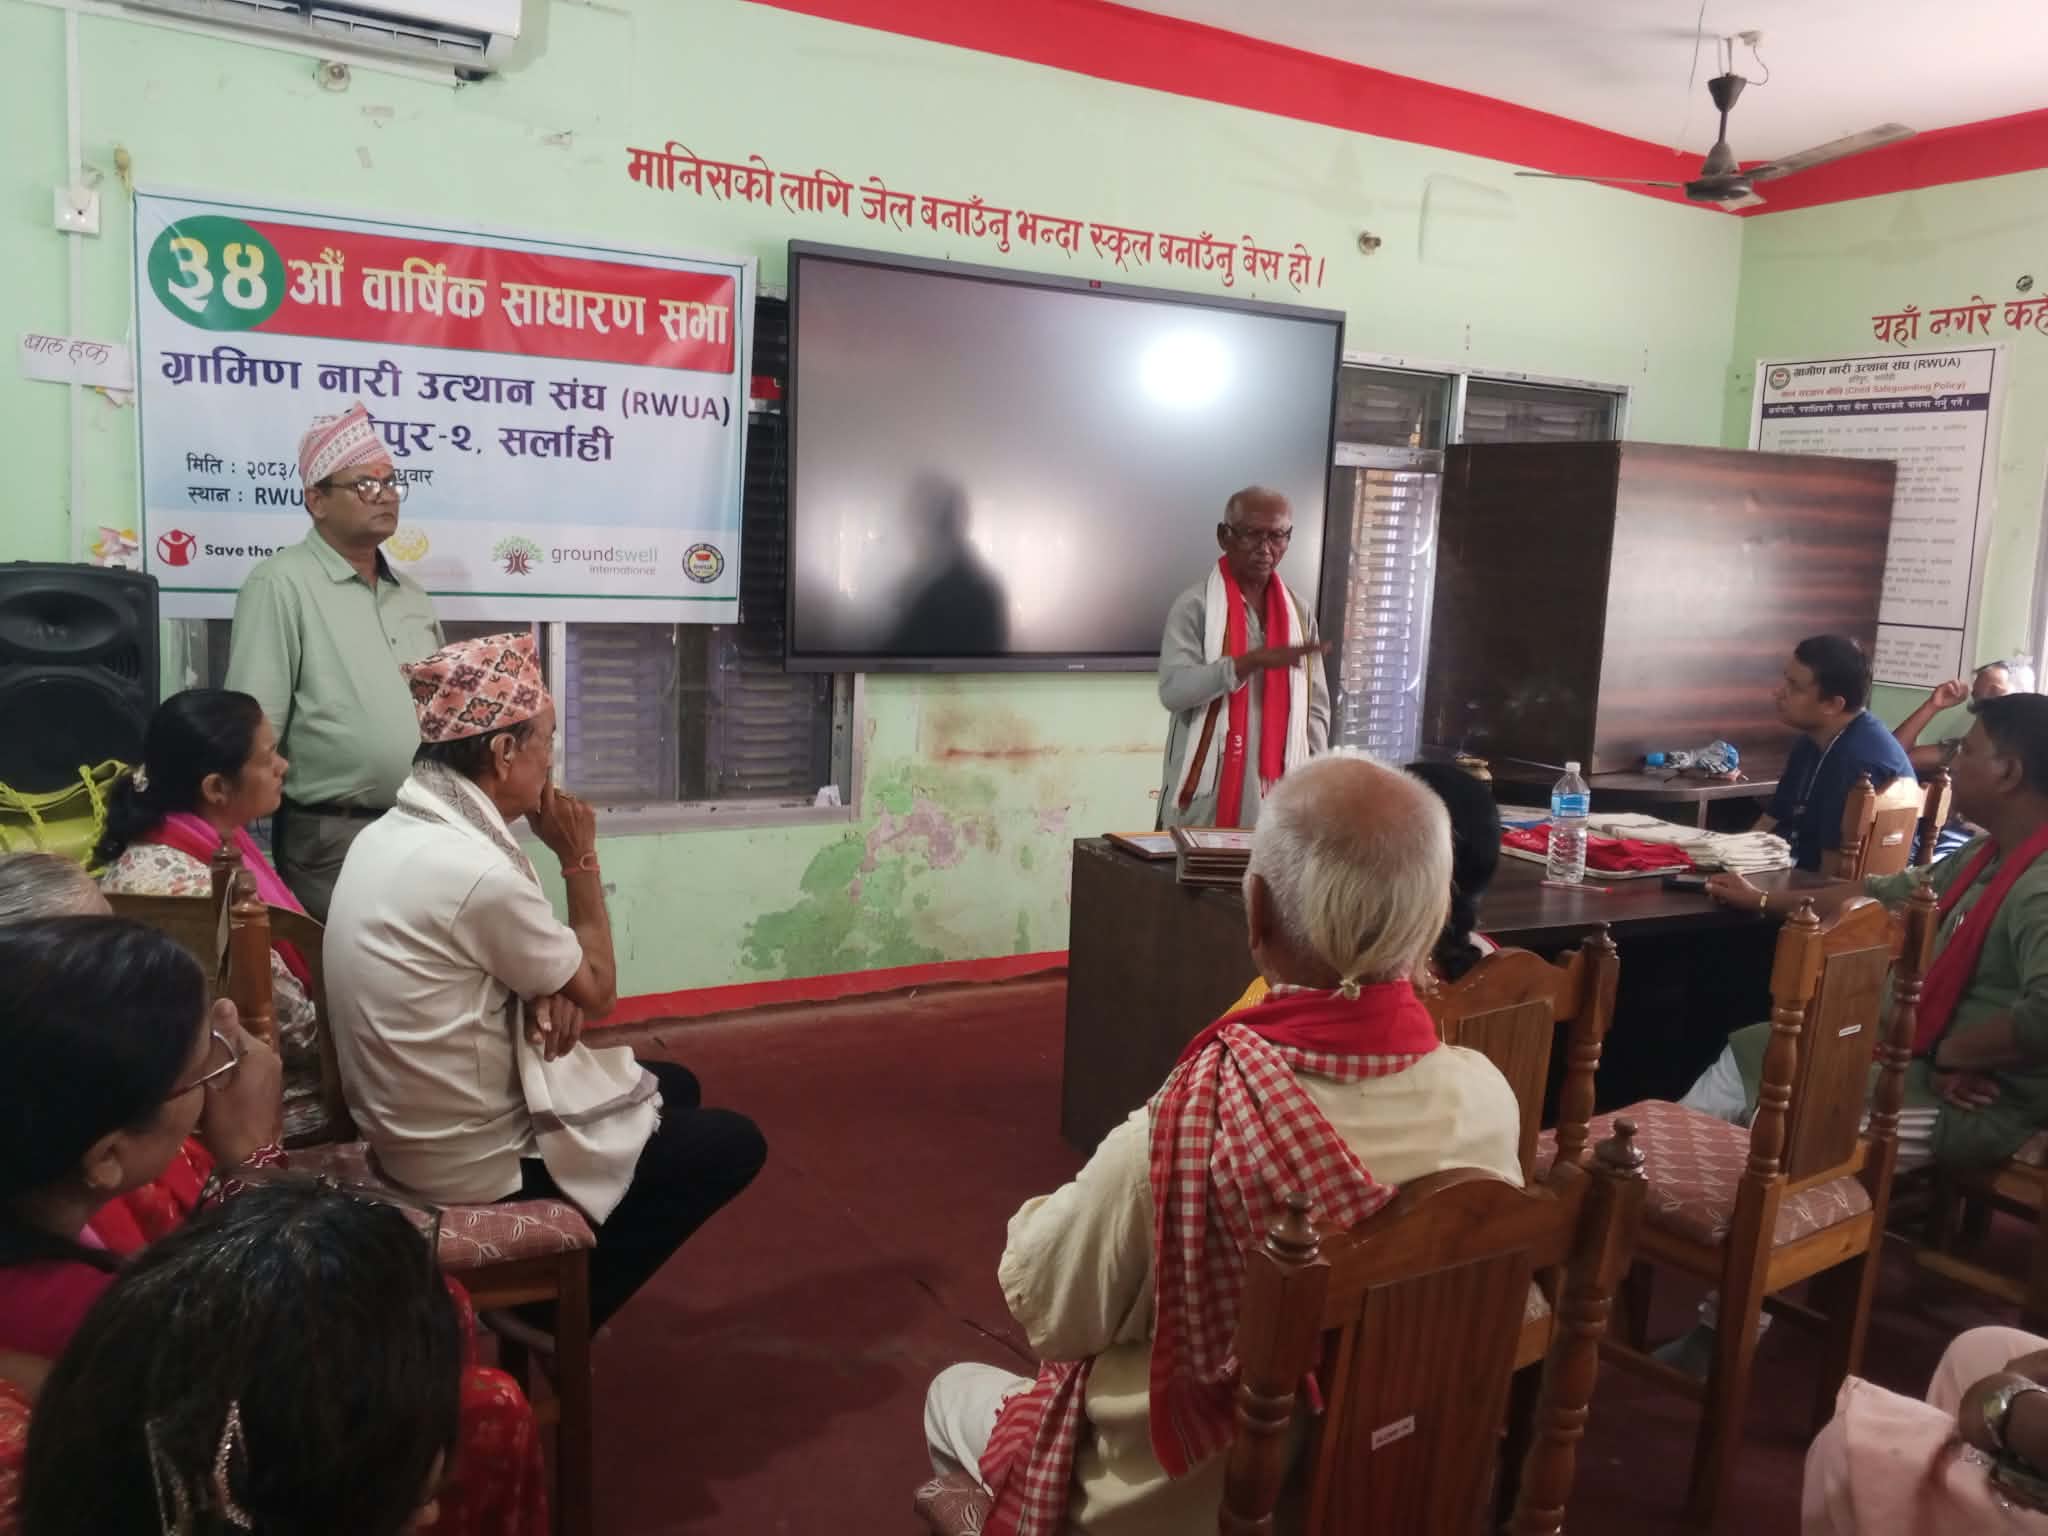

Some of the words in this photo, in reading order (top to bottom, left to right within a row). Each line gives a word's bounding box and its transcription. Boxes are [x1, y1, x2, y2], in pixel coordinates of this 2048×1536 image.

[626, 141, 775, 207] मानिसको
[780, 169, 854, 217] लागि
[860, 176, 915, 232] जेल
[1016, 210, 1084, 259] भन्दा
[1090, 223, 1154, 272] स्कूल
[1242, 235, 1284, 282] बेस
[168, 237, 268, 312] ३४
[362, 257, 488, 318] वार्षिक
[501, 281, 646, 335] साधारण
[658, 298, 729, 345] सभा
[1872, 304, 1921, 348] यहाँ
[1914, 358, 1961, 371] (RWUA)
[160, 345, 302, 389] ग्रामिण
[317, 360, 402, 397] नारी
[418, 371, 534, 406] उत्थान
[549, 377, 607, 411] संघ
[622, 387, 731, 426] (RWUA)
[499, 425, 615, 462] सर्लाही
[186, 452, 224, 473] मिति
[247, 461, 297, 480] २०८३/
[187, 486, 231, 504] स्थान
[255, 487, 304, 506] RWU
[205, 544, 244, 557] Save
[248, 545, 273, 557] the
[551, 546, 657, 564] groundswell
[590, 565, 656, 577] international
